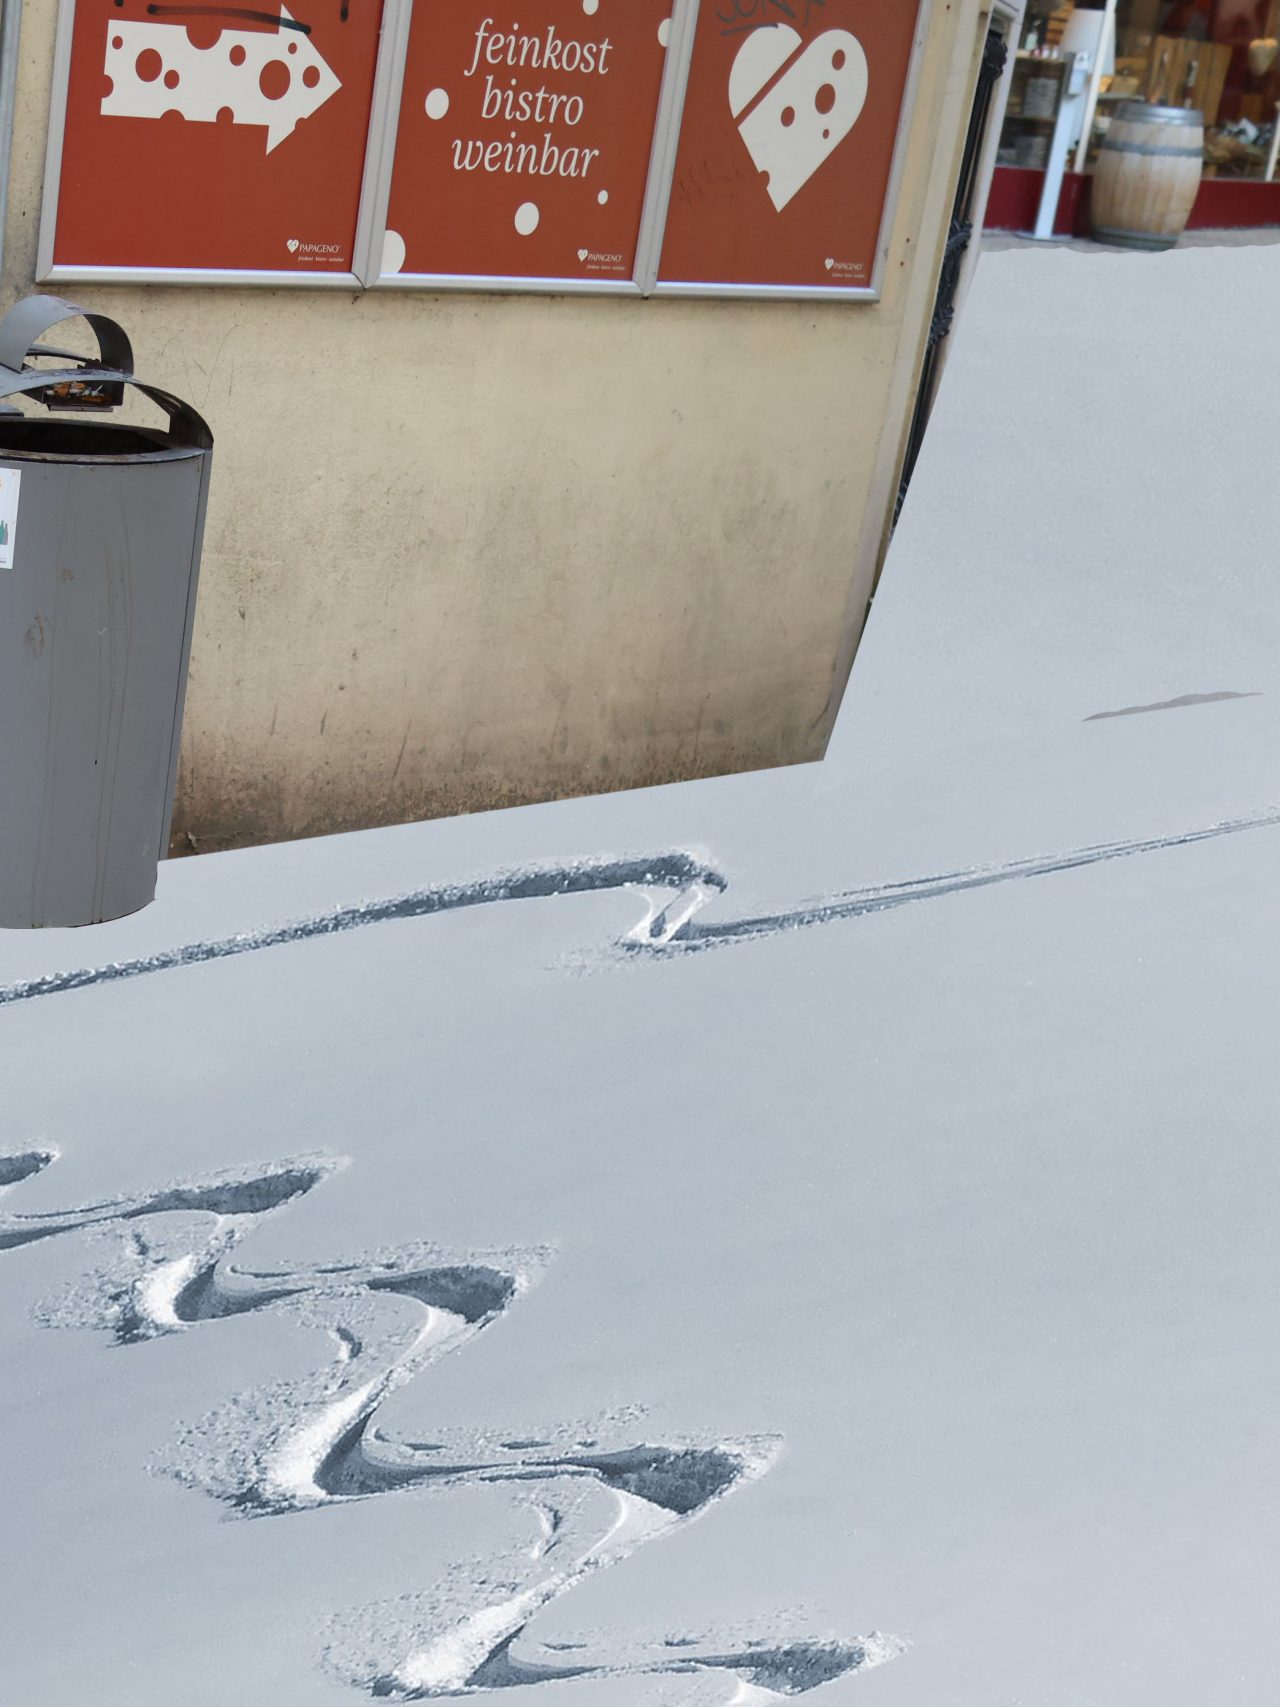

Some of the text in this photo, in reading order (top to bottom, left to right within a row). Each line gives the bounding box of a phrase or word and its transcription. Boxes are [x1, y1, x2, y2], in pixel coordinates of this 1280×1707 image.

[463, 18, 613, 76] feinkost
[481, 75, 584, 125] bistro
[452, 131, 600, 178] weinbar
[299, 244, 339, 253] PAPAGENO
